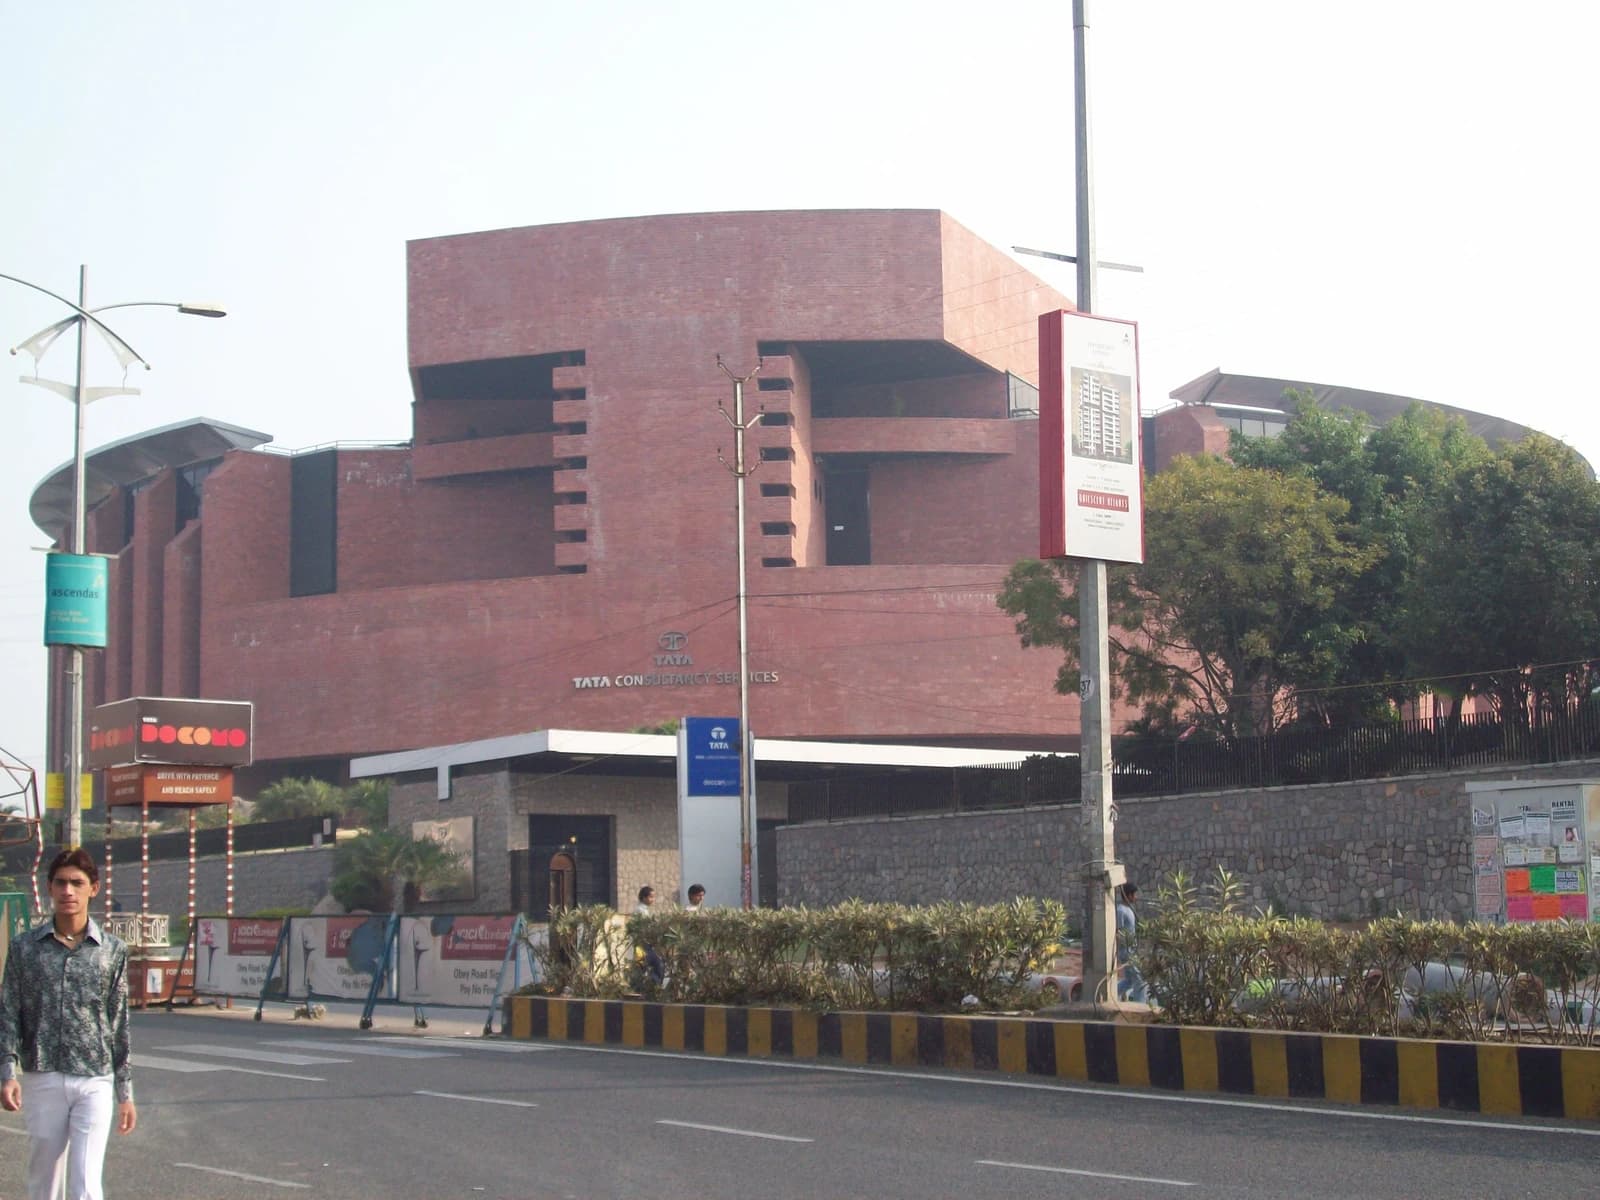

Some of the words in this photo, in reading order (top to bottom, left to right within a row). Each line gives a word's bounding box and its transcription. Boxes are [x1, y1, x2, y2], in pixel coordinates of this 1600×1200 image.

[51, 588, 99, 599] ascendas
[654, 655, 693, 666] TATA
[573, 675, 611, 688] TATA
[615, 671, 712, 687] CONSULTANCY
[716, 671, 779, 684] SERICES
[141, 724, 246, 747] DOCOMO
[708, 742, 729, 750] TATA
[195, 786, 217, 794] SAFELY
[471, 968, 488, 979] Road
[472, 983, 482, 994] No
